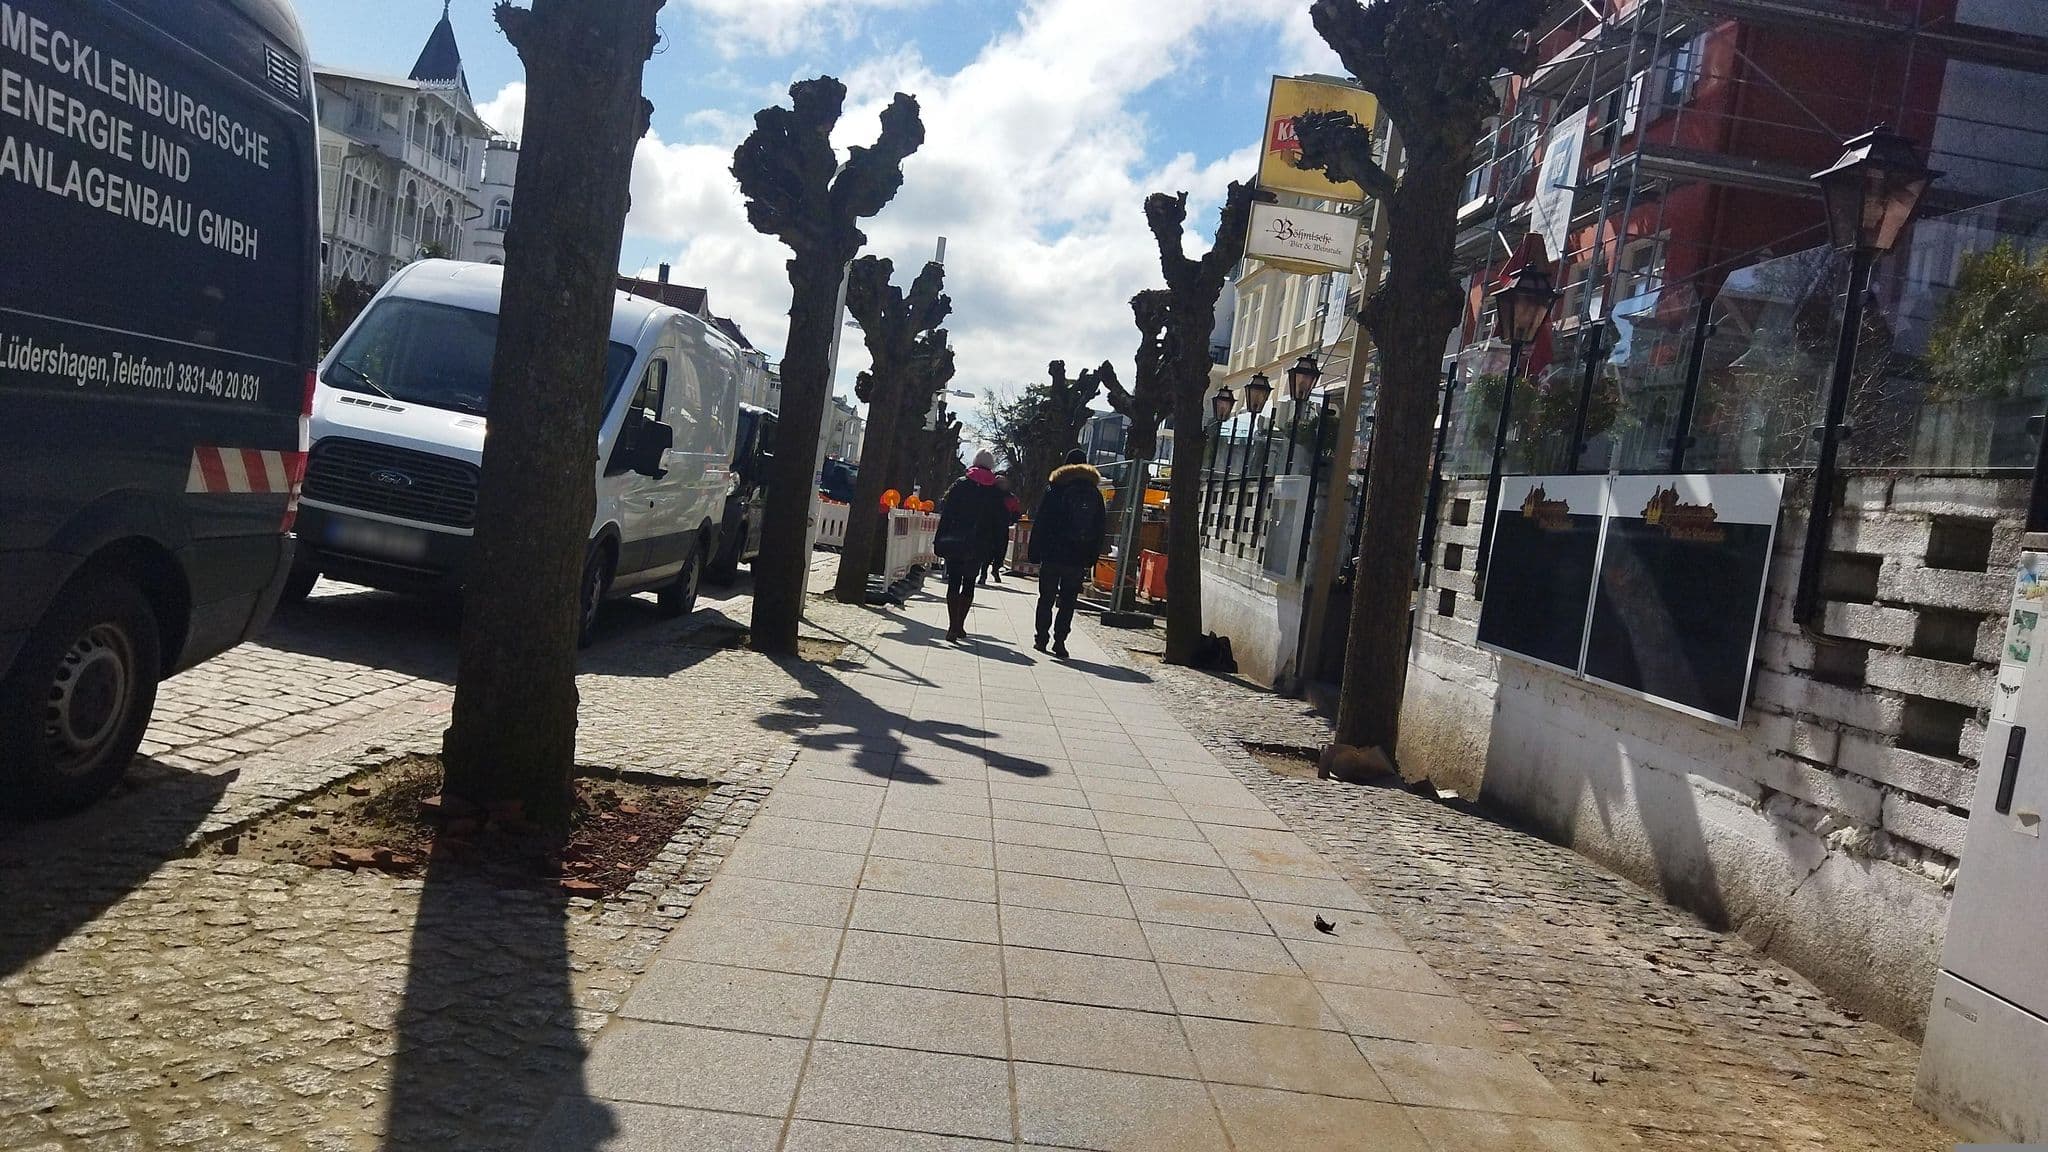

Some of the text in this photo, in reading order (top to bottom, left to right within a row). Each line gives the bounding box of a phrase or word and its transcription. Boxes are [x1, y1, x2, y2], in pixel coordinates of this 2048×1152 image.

[1, 3, 270, 169] MECKLENBURGISCHE
[1, 69, 191, 183] ENERGIE UND
[0, 136, 258, 260] ANLAGENBAU GMBH
[176, 363, 222, 396] 3831-48
[224, 371, 239, 399] 20
[241, 374, 260, 401] 831
